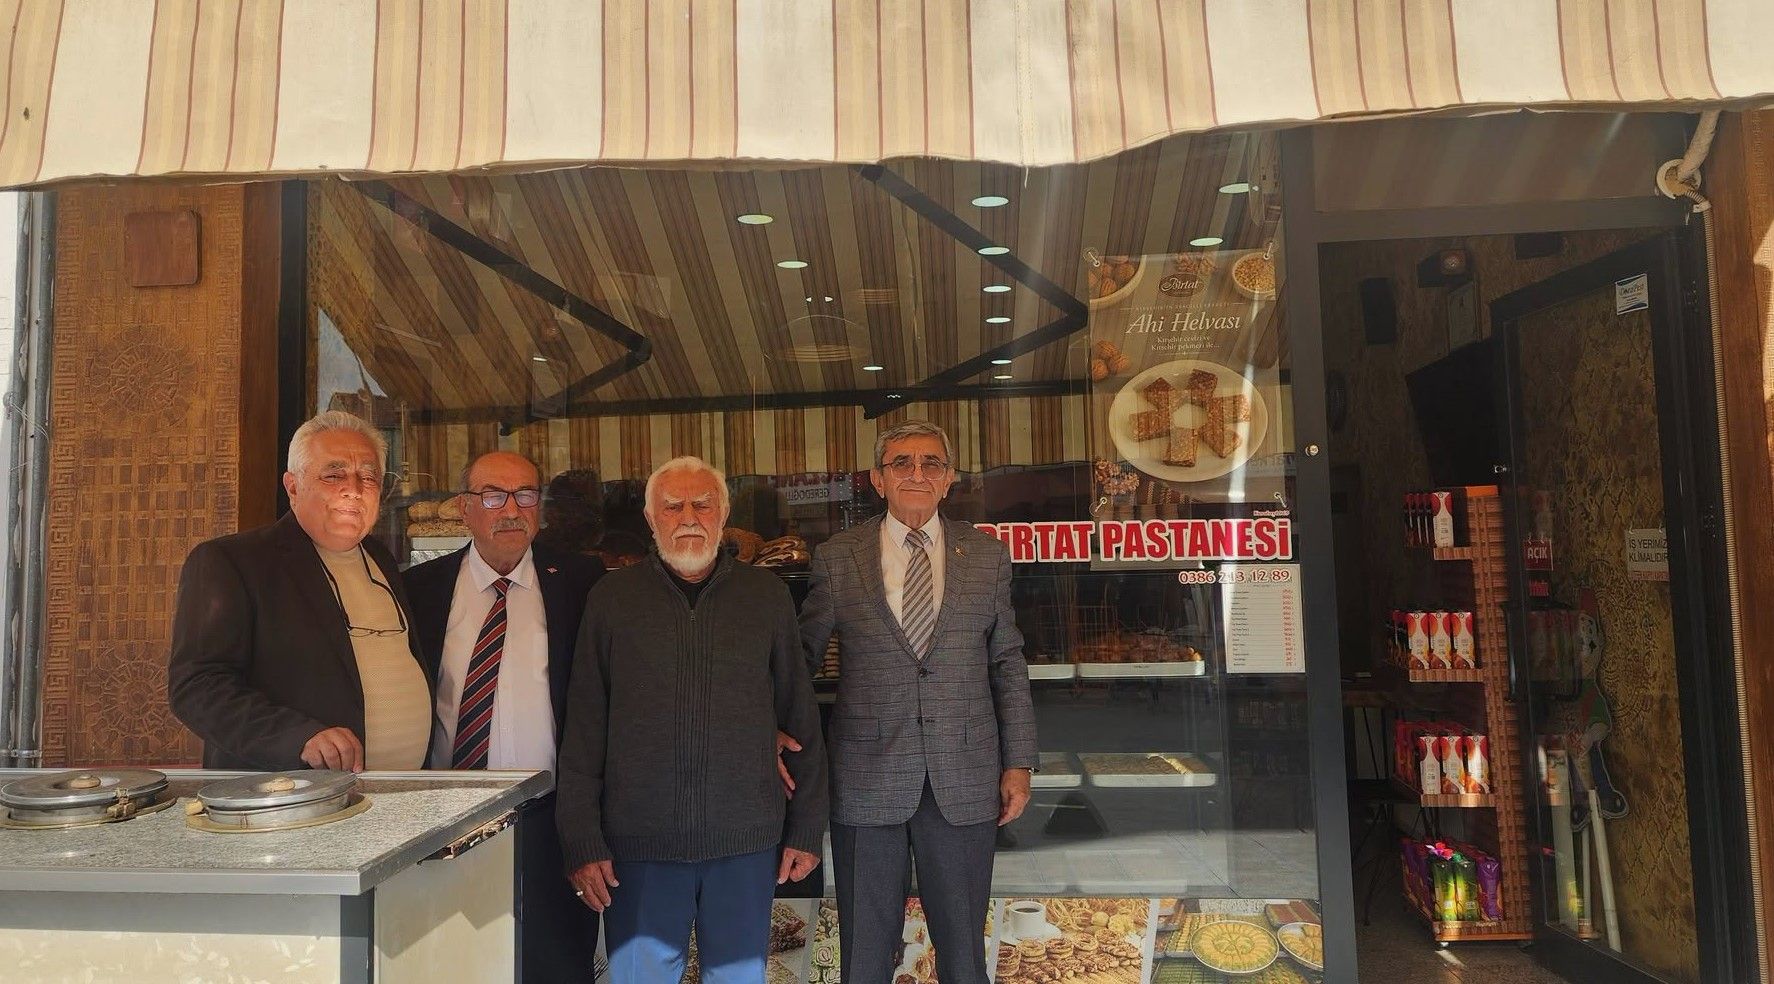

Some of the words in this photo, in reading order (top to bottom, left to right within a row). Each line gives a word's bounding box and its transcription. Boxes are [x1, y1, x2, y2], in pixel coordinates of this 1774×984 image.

[1125, 313, 1165, 334] Ahi
[1171, 311, 1241, 332] Helvası
[973, 521, 1095, 563] RTAT
[1527, 547, 1548, 564] AÇIK
[1178, 570, 1216, 585] 0386
[1218, 569, 1246, 584] 213
[1251, 569, 1269, 584] 12
[1271, 569, 1291, 583] 89
